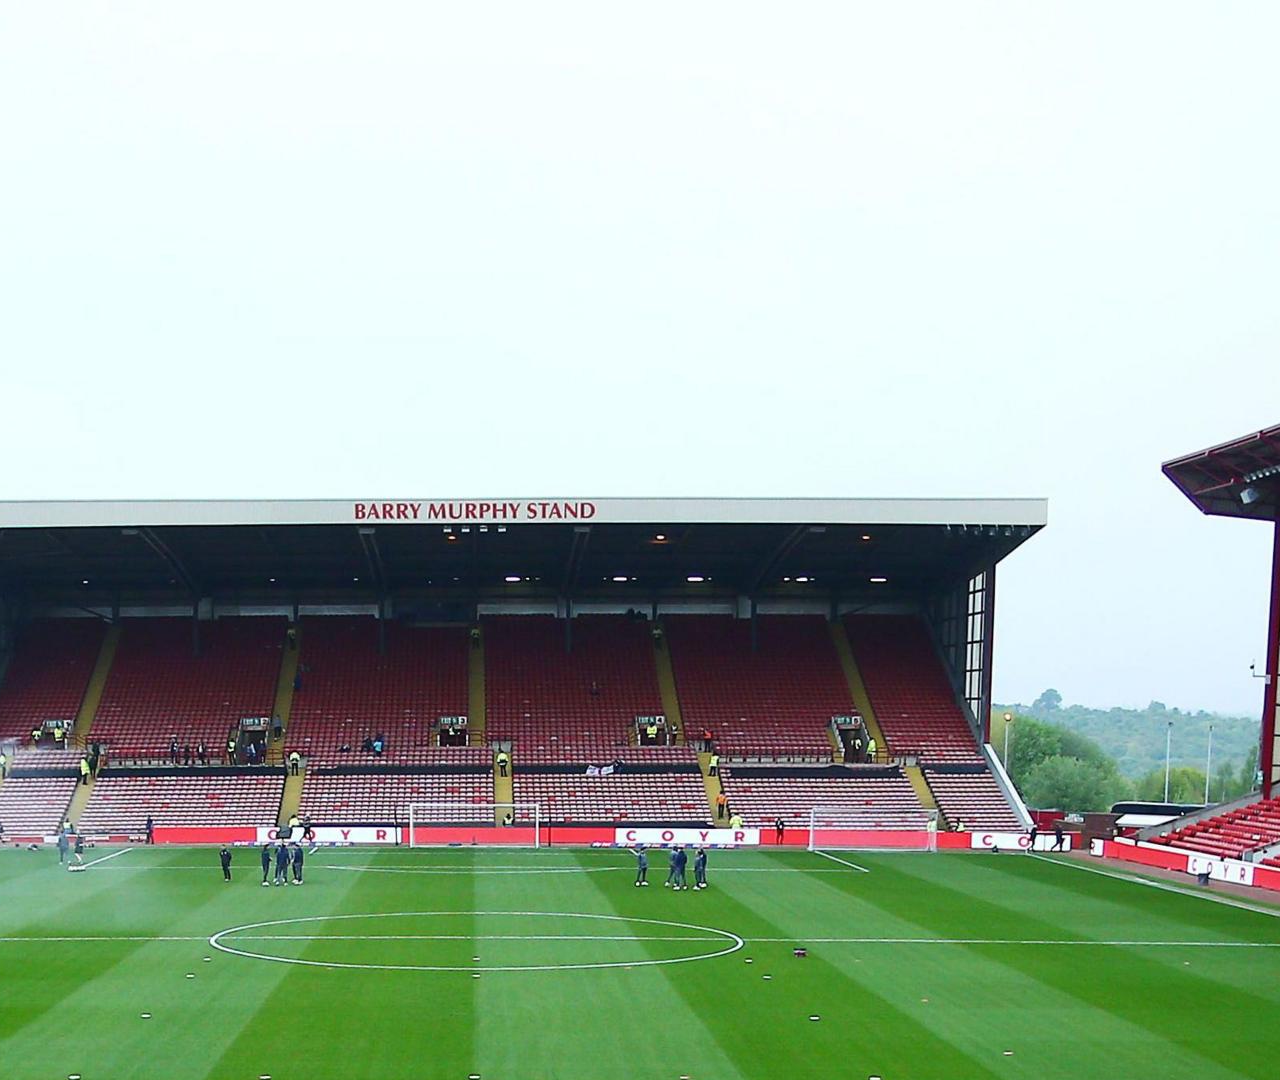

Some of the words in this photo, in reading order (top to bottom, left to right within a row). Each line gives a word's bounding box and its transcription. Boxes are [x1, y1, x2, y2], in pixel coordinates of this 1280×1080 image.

[354, 503, 421, 519] BARRY
[428, 503, 521, 519] MURPHY
[526, 502, 596, 519] STAND
[626, 830, 745, 842] COYR
